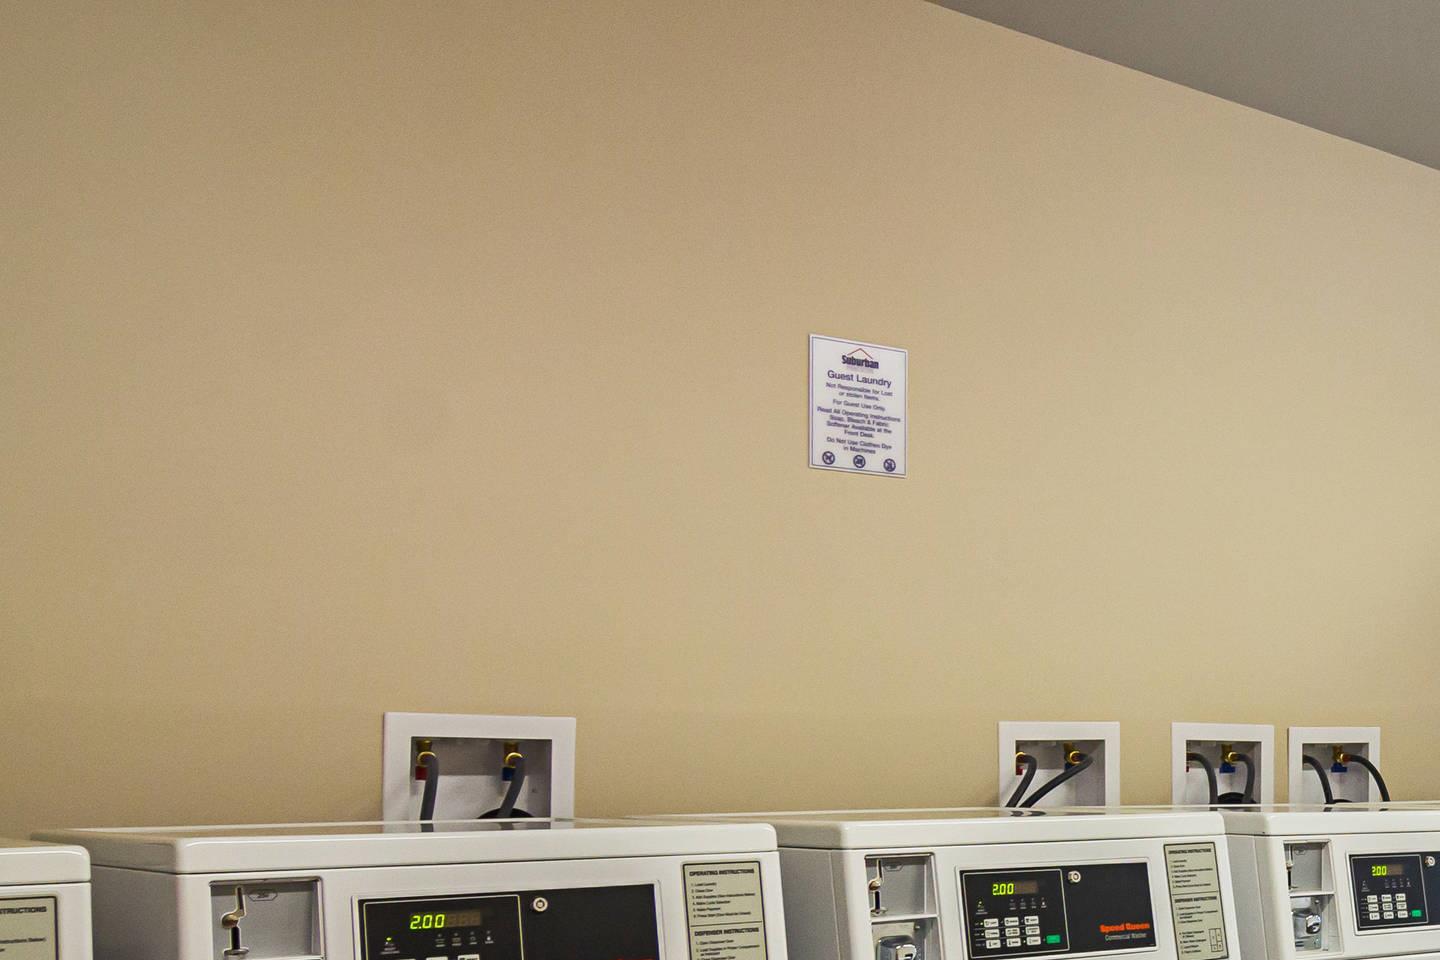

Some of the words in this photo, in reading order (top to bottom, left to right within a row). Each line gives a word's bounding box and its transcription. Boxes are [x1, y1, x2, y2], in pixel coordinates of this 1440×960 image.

[841, 355, 879, 369] Suburban
[827, 370, 854, 381] Guest
[856, 374, 892, 388] Laundry
[410, 913, 445, 930] 2.00
[1100, 923, 1125, 933] Speed
